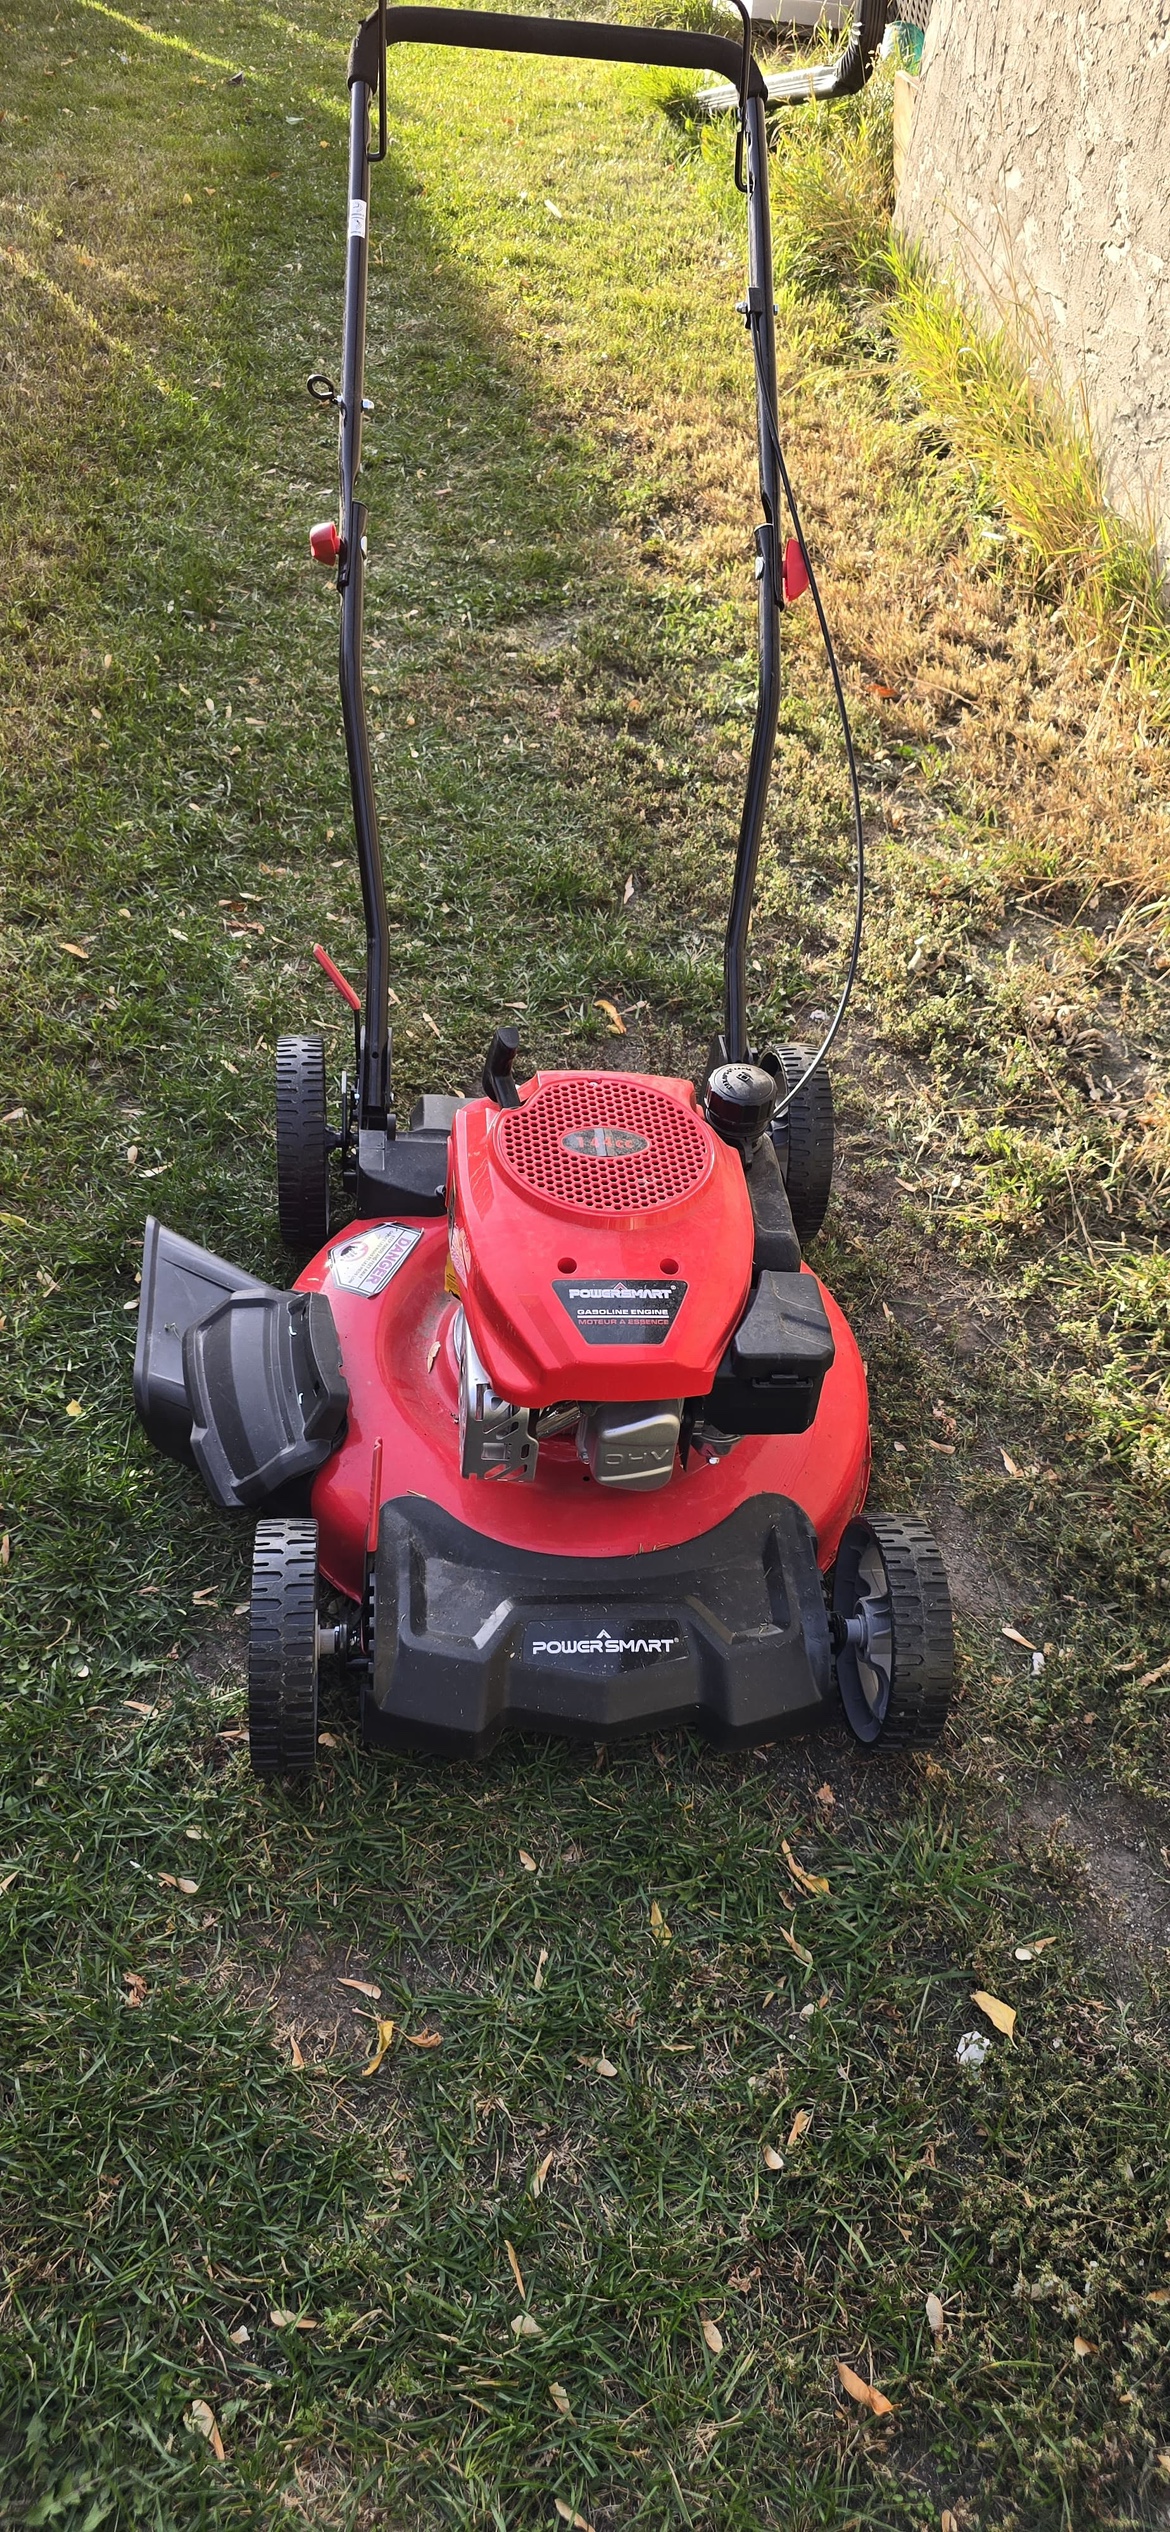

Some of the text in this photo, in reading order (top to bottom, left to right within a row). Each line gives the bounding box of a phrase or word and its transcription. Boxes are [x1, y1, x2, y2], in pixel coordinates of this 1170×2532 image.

[365, 1237, 412, 1285] DANGER
[568, 1288, 672, 1299] POWERSMART
[605, 1449, 670, 1464] OHV
[532, 1639, 675, 1655] POWERSMART
